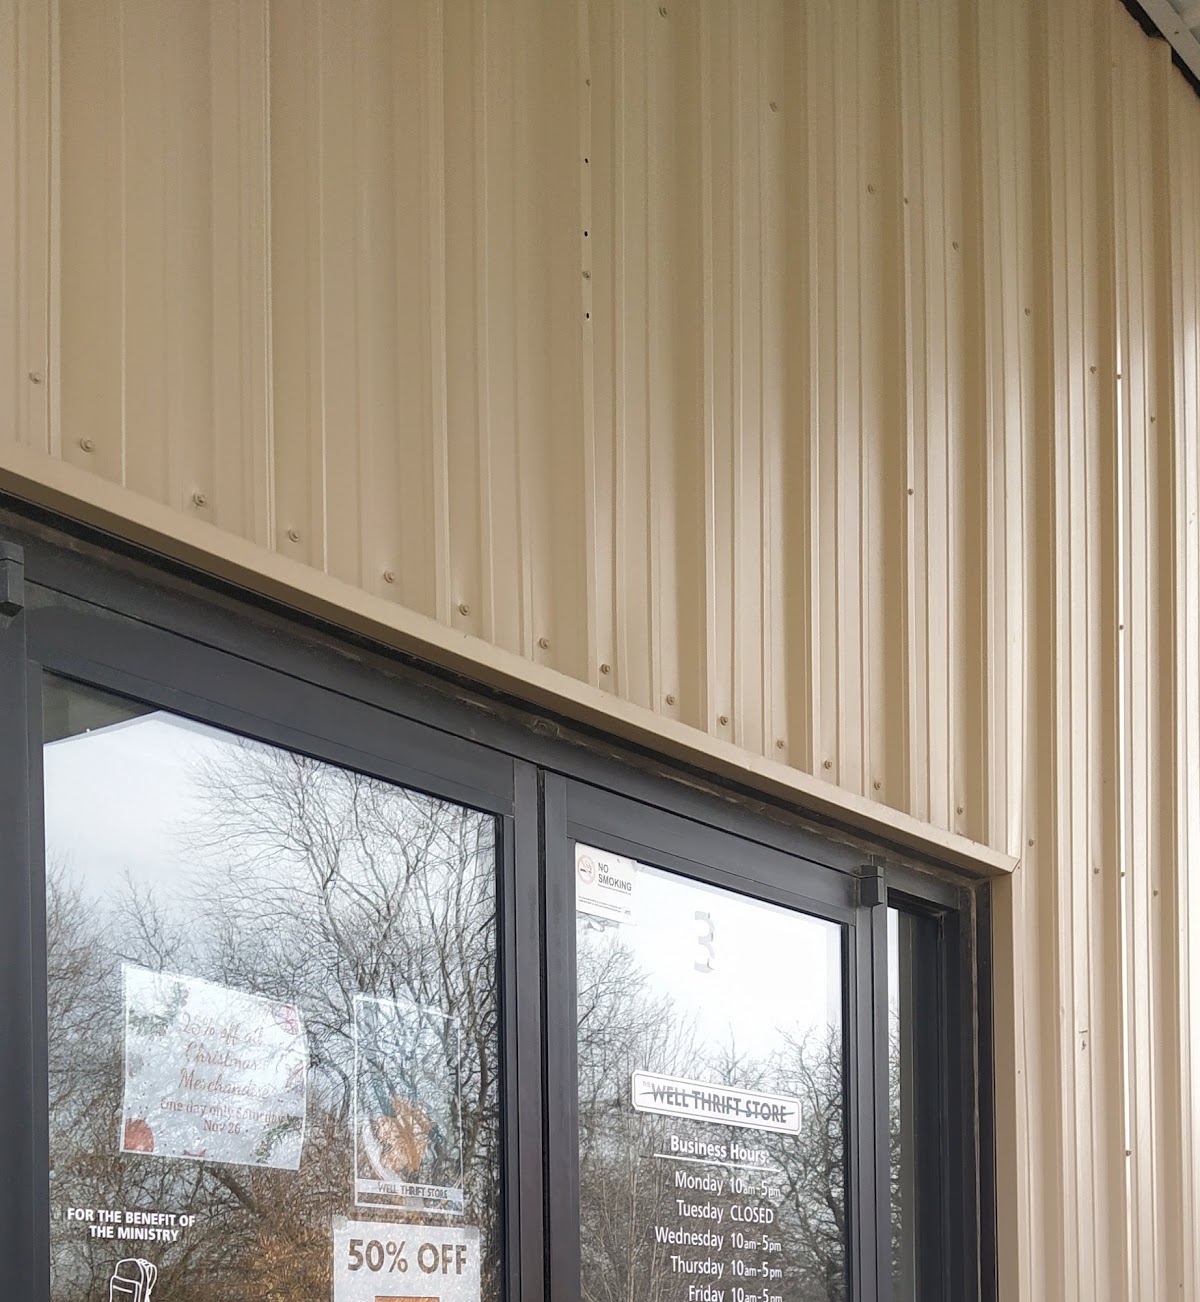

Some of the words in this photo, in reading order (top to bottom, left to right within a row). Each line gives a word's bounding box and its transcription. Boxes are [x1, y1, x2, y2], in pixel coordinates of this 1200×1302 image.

[598, 862, 608, 873] NO
[598, 874, 632, 891] SMOKING
[221, 1022, 240, 1046] off
[186, 1041, 257, 1070] Christmas
[161, 1097, 183, 1112] One
[186, 1100, 207, 1118] day
[652, 1083, 689, 1108] WELL
[692, 1090, 742, 1116] THRIFT
[746, 1099, 786, 1123] STORE
[203, 1119, 225, 1132] Nov
[228, 1123, 240, 1134] 26
[670, 1135, 727, 1158] Business
[730, 1143, 770, 1164] Hours:
[378, 1182, 398, 1193] WELL
[400, 1185, 425, 1196] THRIFT
[427, 1188, 448, 1199] STORE
[675, 1170, 724, 1196] Monday
[67, 1208, 93, 1221] FOR
[98, 1210, 121, 1223] THE
[126, 1212, 176, 1226] BENEFIT
[179, 1215, 196, 1228] OF
[676, 1200, 724, 1224] Tuesday
[730, 1205, 774, 1224] CLOSED
[89, 1225, 113, 1238] THE
[118, 1227, 179, 1242] MINISTRY
[655, 1226, 724, 1251] Wednesday
[348, 1239, 408, 1273] 50%
[417, 1242, 467, 1274] OFF
[671, 1255, 724, 1280] Thursday
